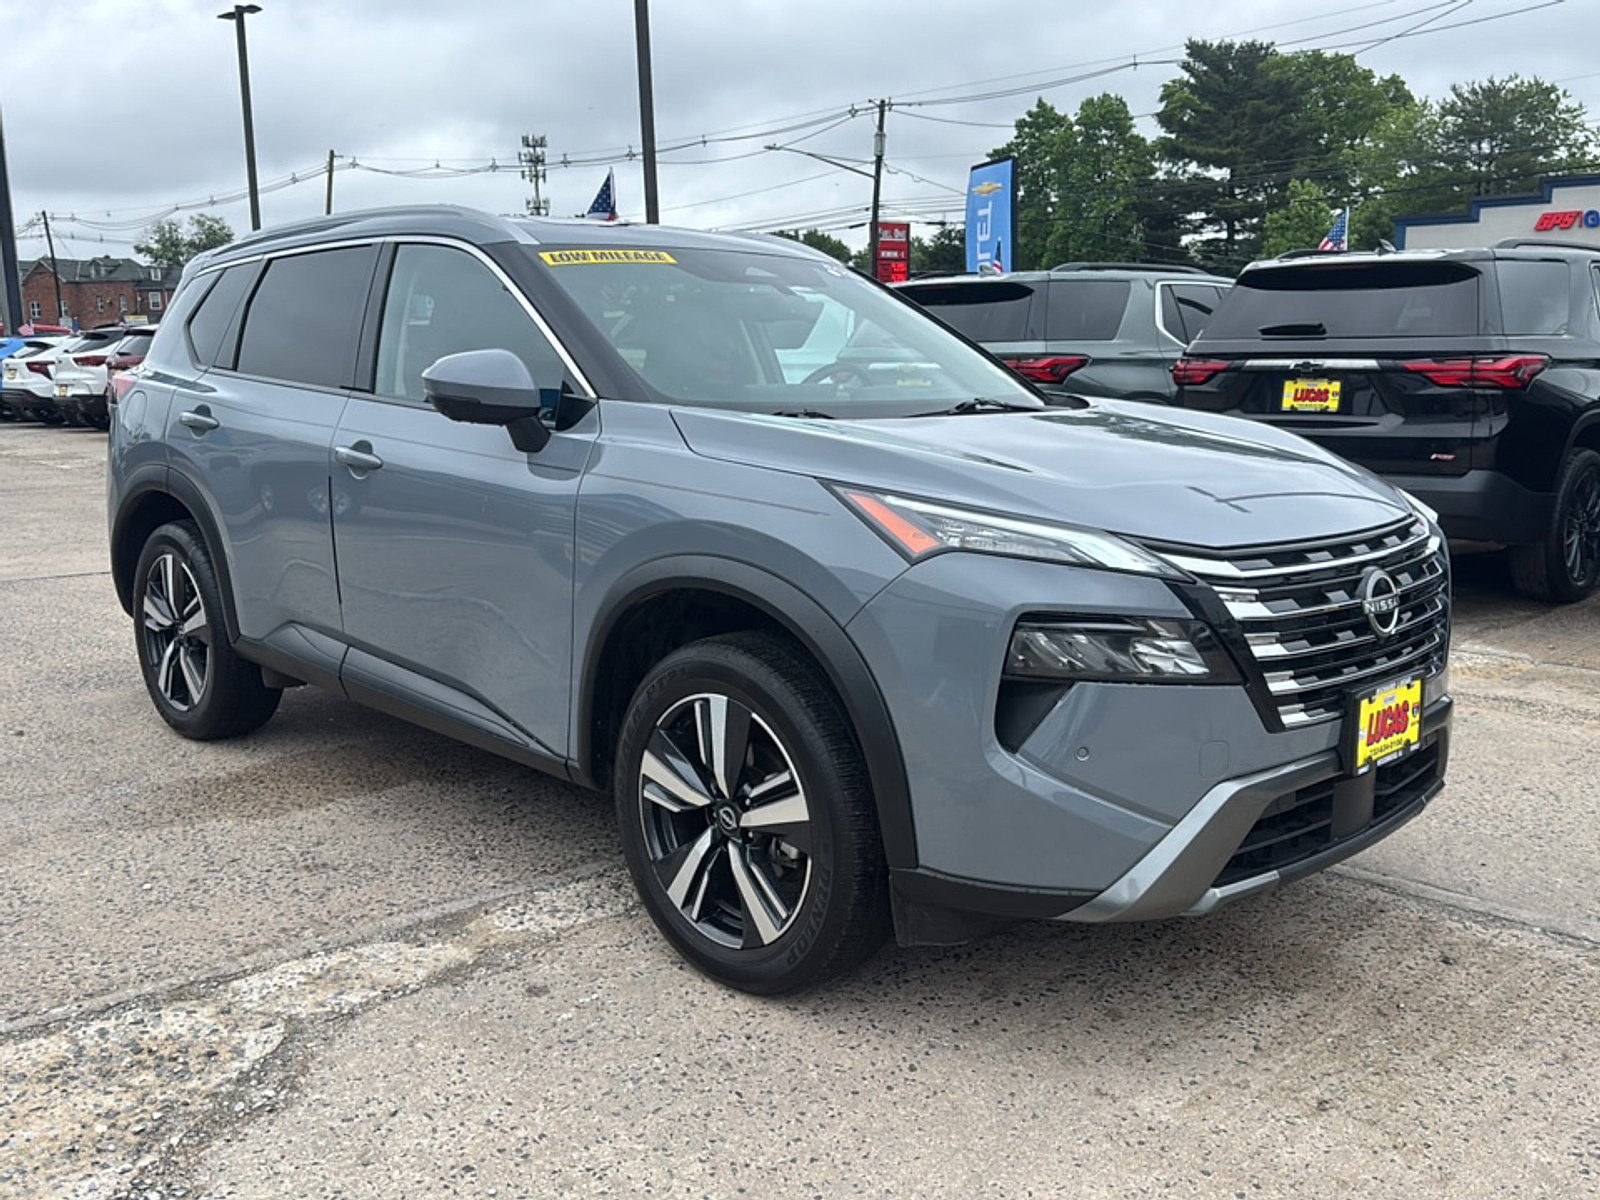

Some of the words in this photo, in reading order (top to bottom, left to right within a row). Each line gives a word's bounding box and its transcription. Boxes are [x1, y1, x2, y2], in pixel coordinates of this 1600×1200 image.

[549, 251, 590, 263] LOW
[591, 250, 667, 261] MILEAGE
[1293, 388, 1330, 403] LUCAS
[1367, 700, 1410, 746] LUCAS
